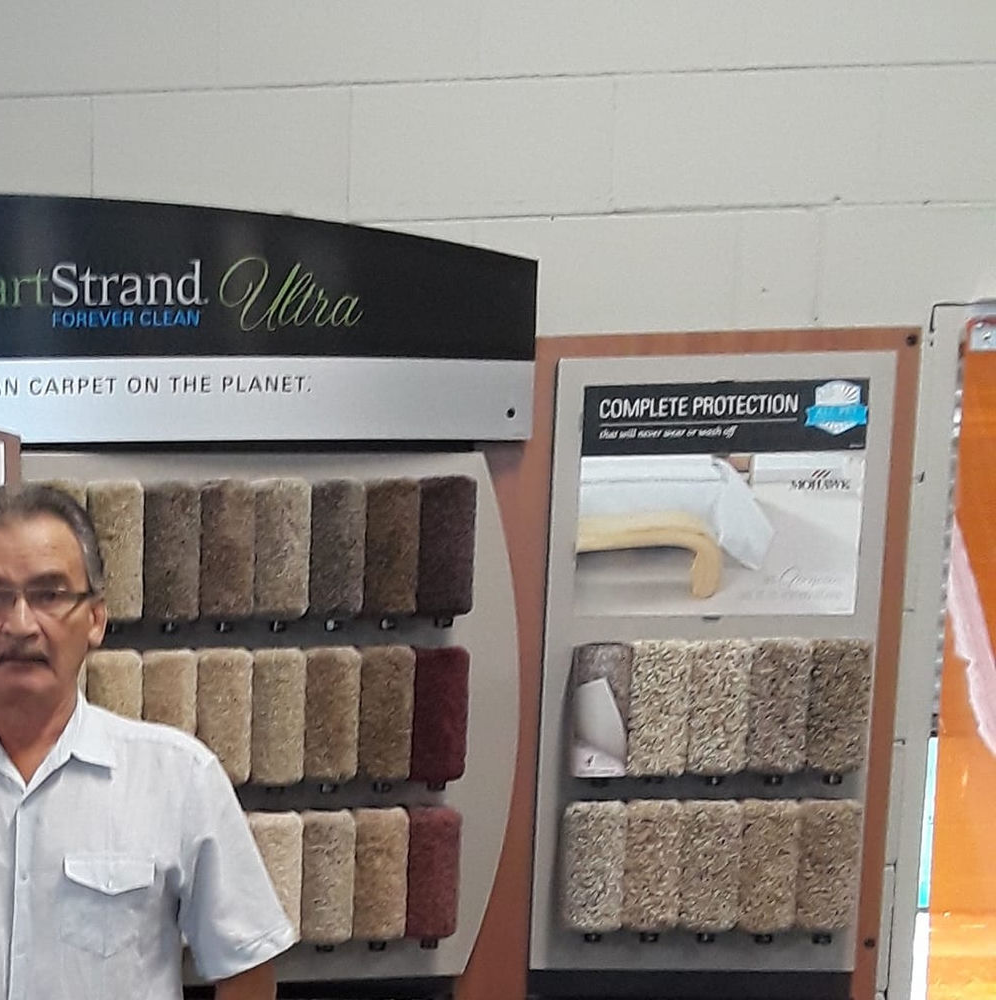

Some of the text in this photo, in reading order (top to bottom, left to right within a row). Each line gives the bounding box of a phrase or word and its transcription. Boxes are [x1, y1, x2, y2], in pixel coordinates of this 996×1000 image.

[219, 256, 363, 331] Ultra
[52, 310, 202, 329] FOREVER CLEAN
[28, 376, 116, 395] CARPET
[127, 376, 158, 394] ON
[168, 375, 211, 394] THE
[599, 393, 799, 419] COMPLETE PROTECTION
